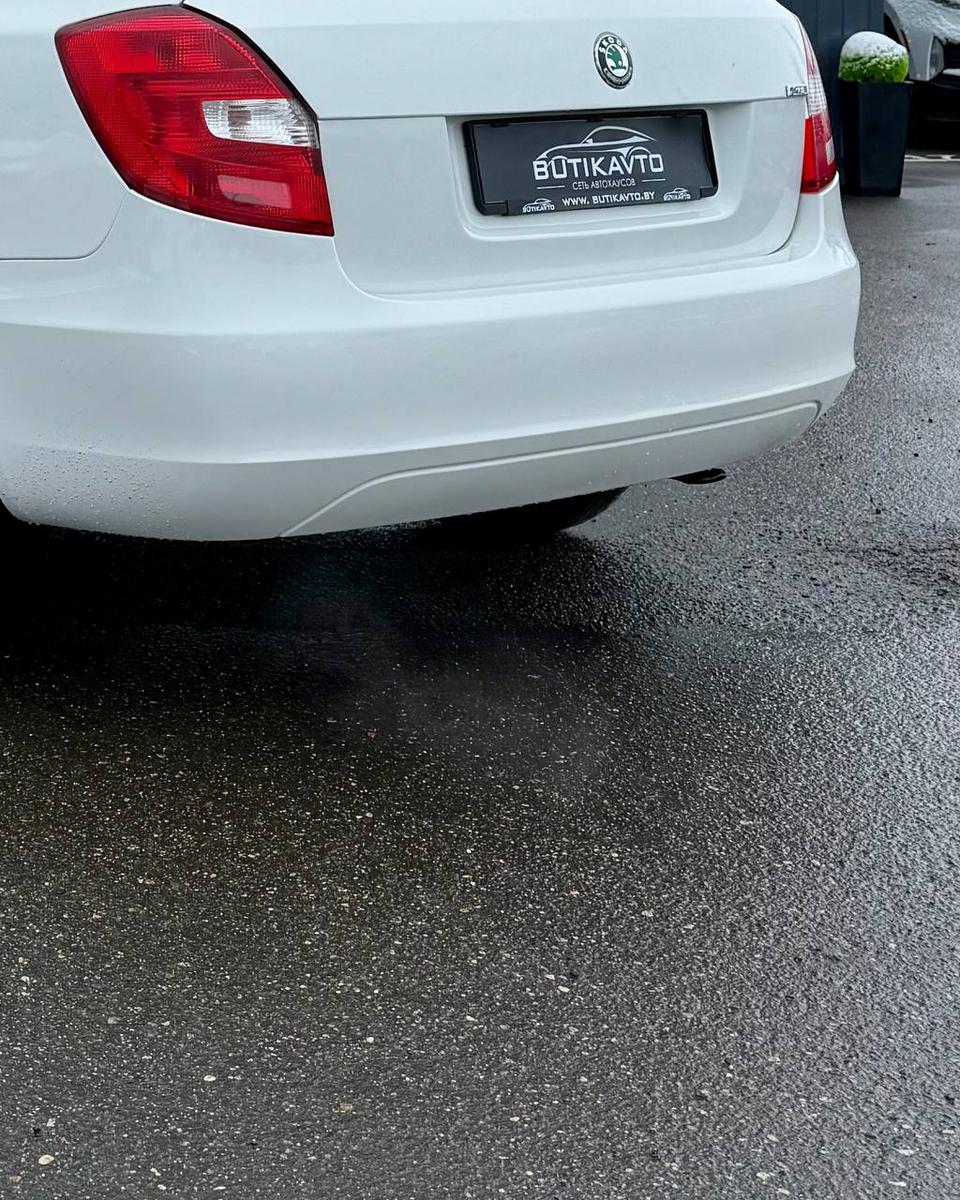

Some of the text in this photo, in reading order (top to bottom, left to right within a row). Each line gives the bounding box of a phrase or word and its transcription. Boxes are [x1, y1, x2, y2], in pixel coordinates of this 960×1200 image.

[532, 153, 665, 181] BUTIKAVTO
[572, 178, 636, 191] СЕТЬ АВТОХАУСОВ
[562, 191, 656, 206] WWW. BUTIKAVTO.BY
